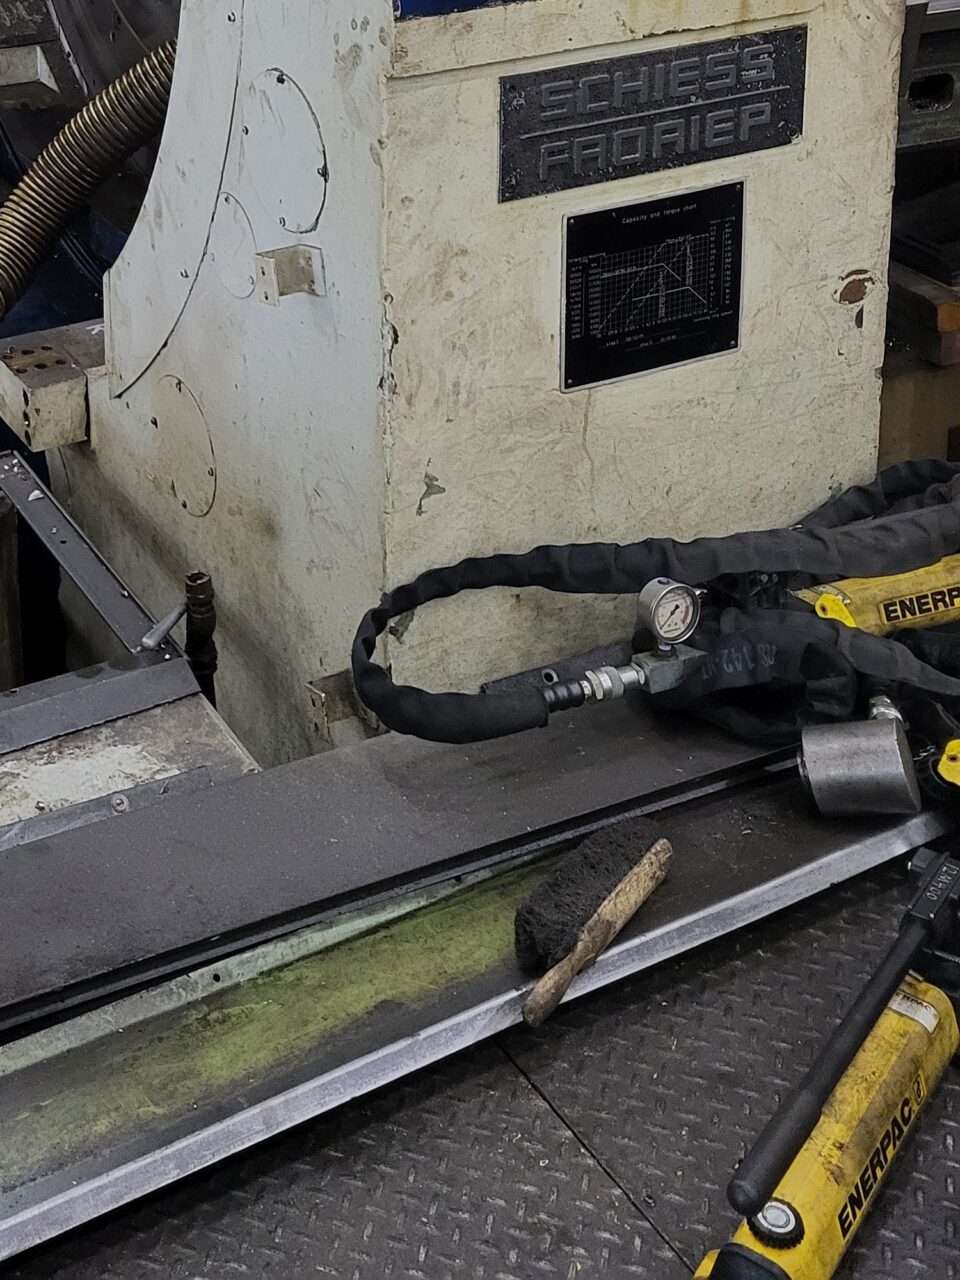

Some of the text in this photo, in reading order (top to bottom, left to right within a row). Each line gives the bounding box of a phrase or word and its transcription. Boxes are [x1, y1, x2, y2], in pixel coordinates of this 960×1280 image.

[540, 43, 775, 122] SCHIESS
[882, 585, 960, 623] ENERP
[837, 1096, 913, 1241] ENERPAC
